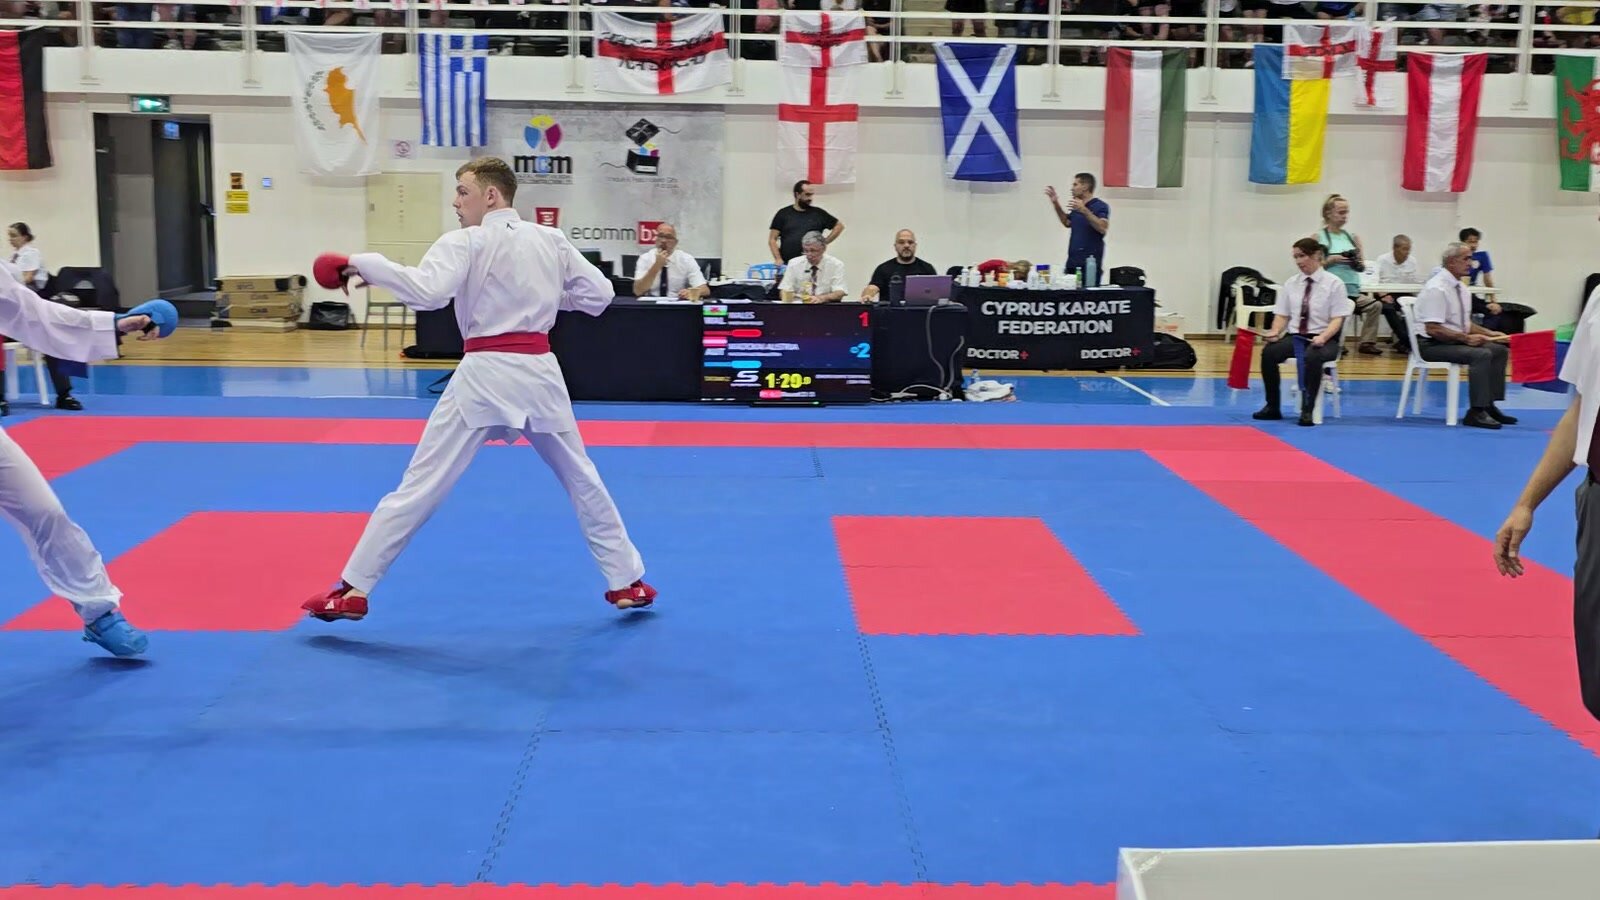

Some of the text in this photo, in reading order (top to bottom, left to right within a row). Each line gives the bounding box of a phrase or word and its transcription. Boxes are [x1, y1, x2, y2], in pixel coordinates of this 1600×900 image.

[981, 300, 1131, 316] CYPRUS KARATE
[858, 311, 869, 327] 1
[998, 320, 1113, 335] FEDERATION
